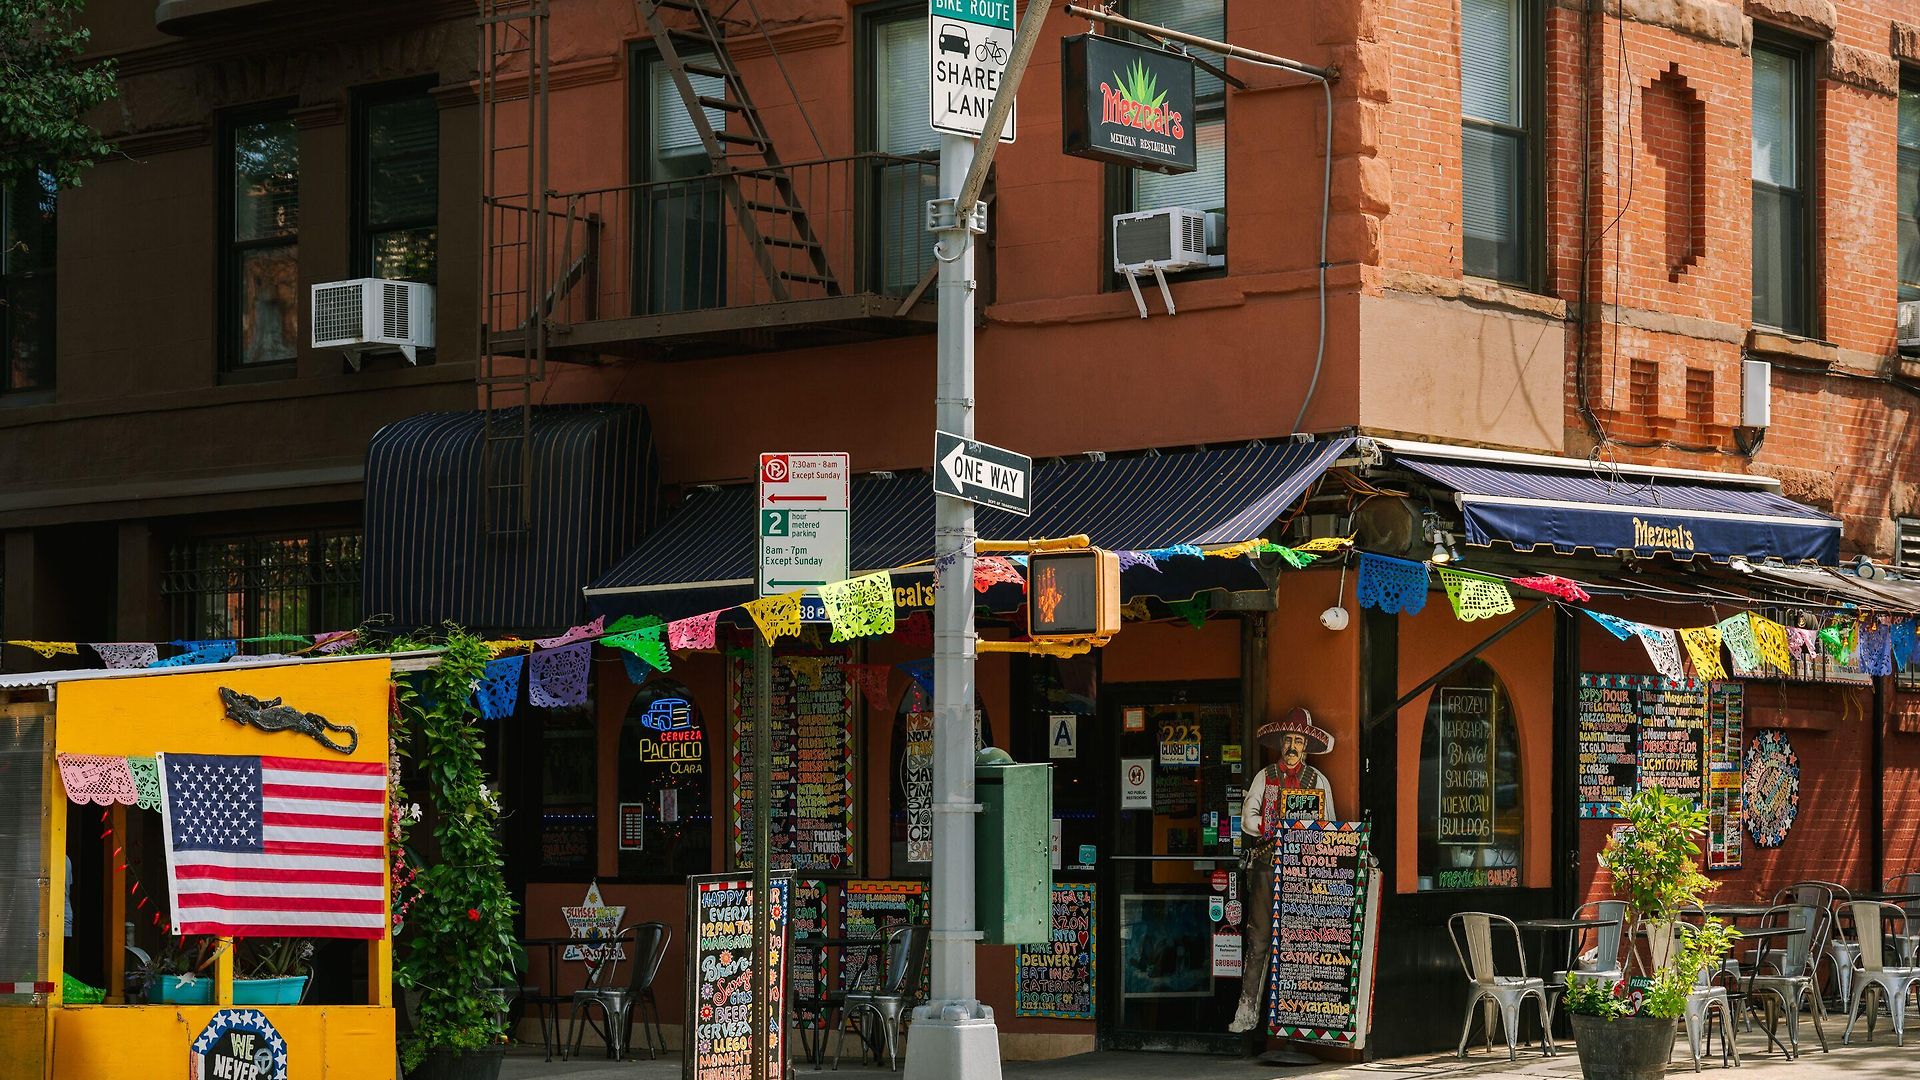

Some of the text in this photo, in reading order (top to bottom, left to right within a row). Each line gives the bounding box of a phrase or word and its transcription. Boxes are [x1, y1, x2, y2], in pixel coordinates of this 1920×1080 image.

[936, 0, 1010, 22] BIKE ROUTE
[1100, 82, 1184, 140] Mezcal's
[1110, 132, 1176, 156] MEXICAN RESTAURANT
[792, 460, 816, 469] 7:30am
[823, 460, 838, 469] 8am
[792, 471, 841, 480] Except Sunday
[954, 455, 1019, 493] ONE WAY
[768, 512, 782, 534] 2
[792, 512, 807, 520] hour
[792, 520, 820, 529] metered
[792, 529, 816, 538] parking
[1633, 517, 1694, 551] Mezcal's
[765, 546, 783, 555] 8am
[791, 546, 807, 556] 7pm
[765, 557, 823, 566] Except Sunday
[894, 581, 936, 607] cal's
[1448, 695, 1488, 714] FROZEN
[660, 730, 702, 742] CERVEZA
[1054, 720, 1072, 746] A
[1163, 725, 1202, 745] 223
[1442, 720, 1493, 739] MARGARITA
[640, 738, 702, 762] PACIFICO
[670, 761, 703, 774] CLARA
[1446, 769, 1490, 789] SANGRIA
[1442, 795, 1490, 814] MEXICAN
[1441, 817, 1490, 837] BULLDOG
[1284, 842, 1300, 854] LOS
[1283, 854, 1338, 868] DEL MOLE
[1282, 866, 1307, 878] MOLE
[702, 890, 745, 908] HAPPY
[709, 906, 748, 922] EVERY
[702, 922, 735, 938] 12PM
[1023, 942, 1078, 954] TAKE OUT
[1022, 954, 1078, 968] DELIVERY
[1215, 959, 1242, 967] GRUBHUB
[1280, 950, 1320, 965] CARNE
[1022, 966, 1048, 980] EAT
[1048, 968, 1062, 980] IN
[1022, 979, 1083, 993] CATERING
[1279, 978, 1297, 990] fish
[715, 1005, 748, 1024] BEER
[230, 1032, 256, 1060] WE
[714, 1036, 747, 1054] LLEGO
[213, 1054, 259, 1080] NEVER
[700, 1050, 752, 1068] MOMENT
